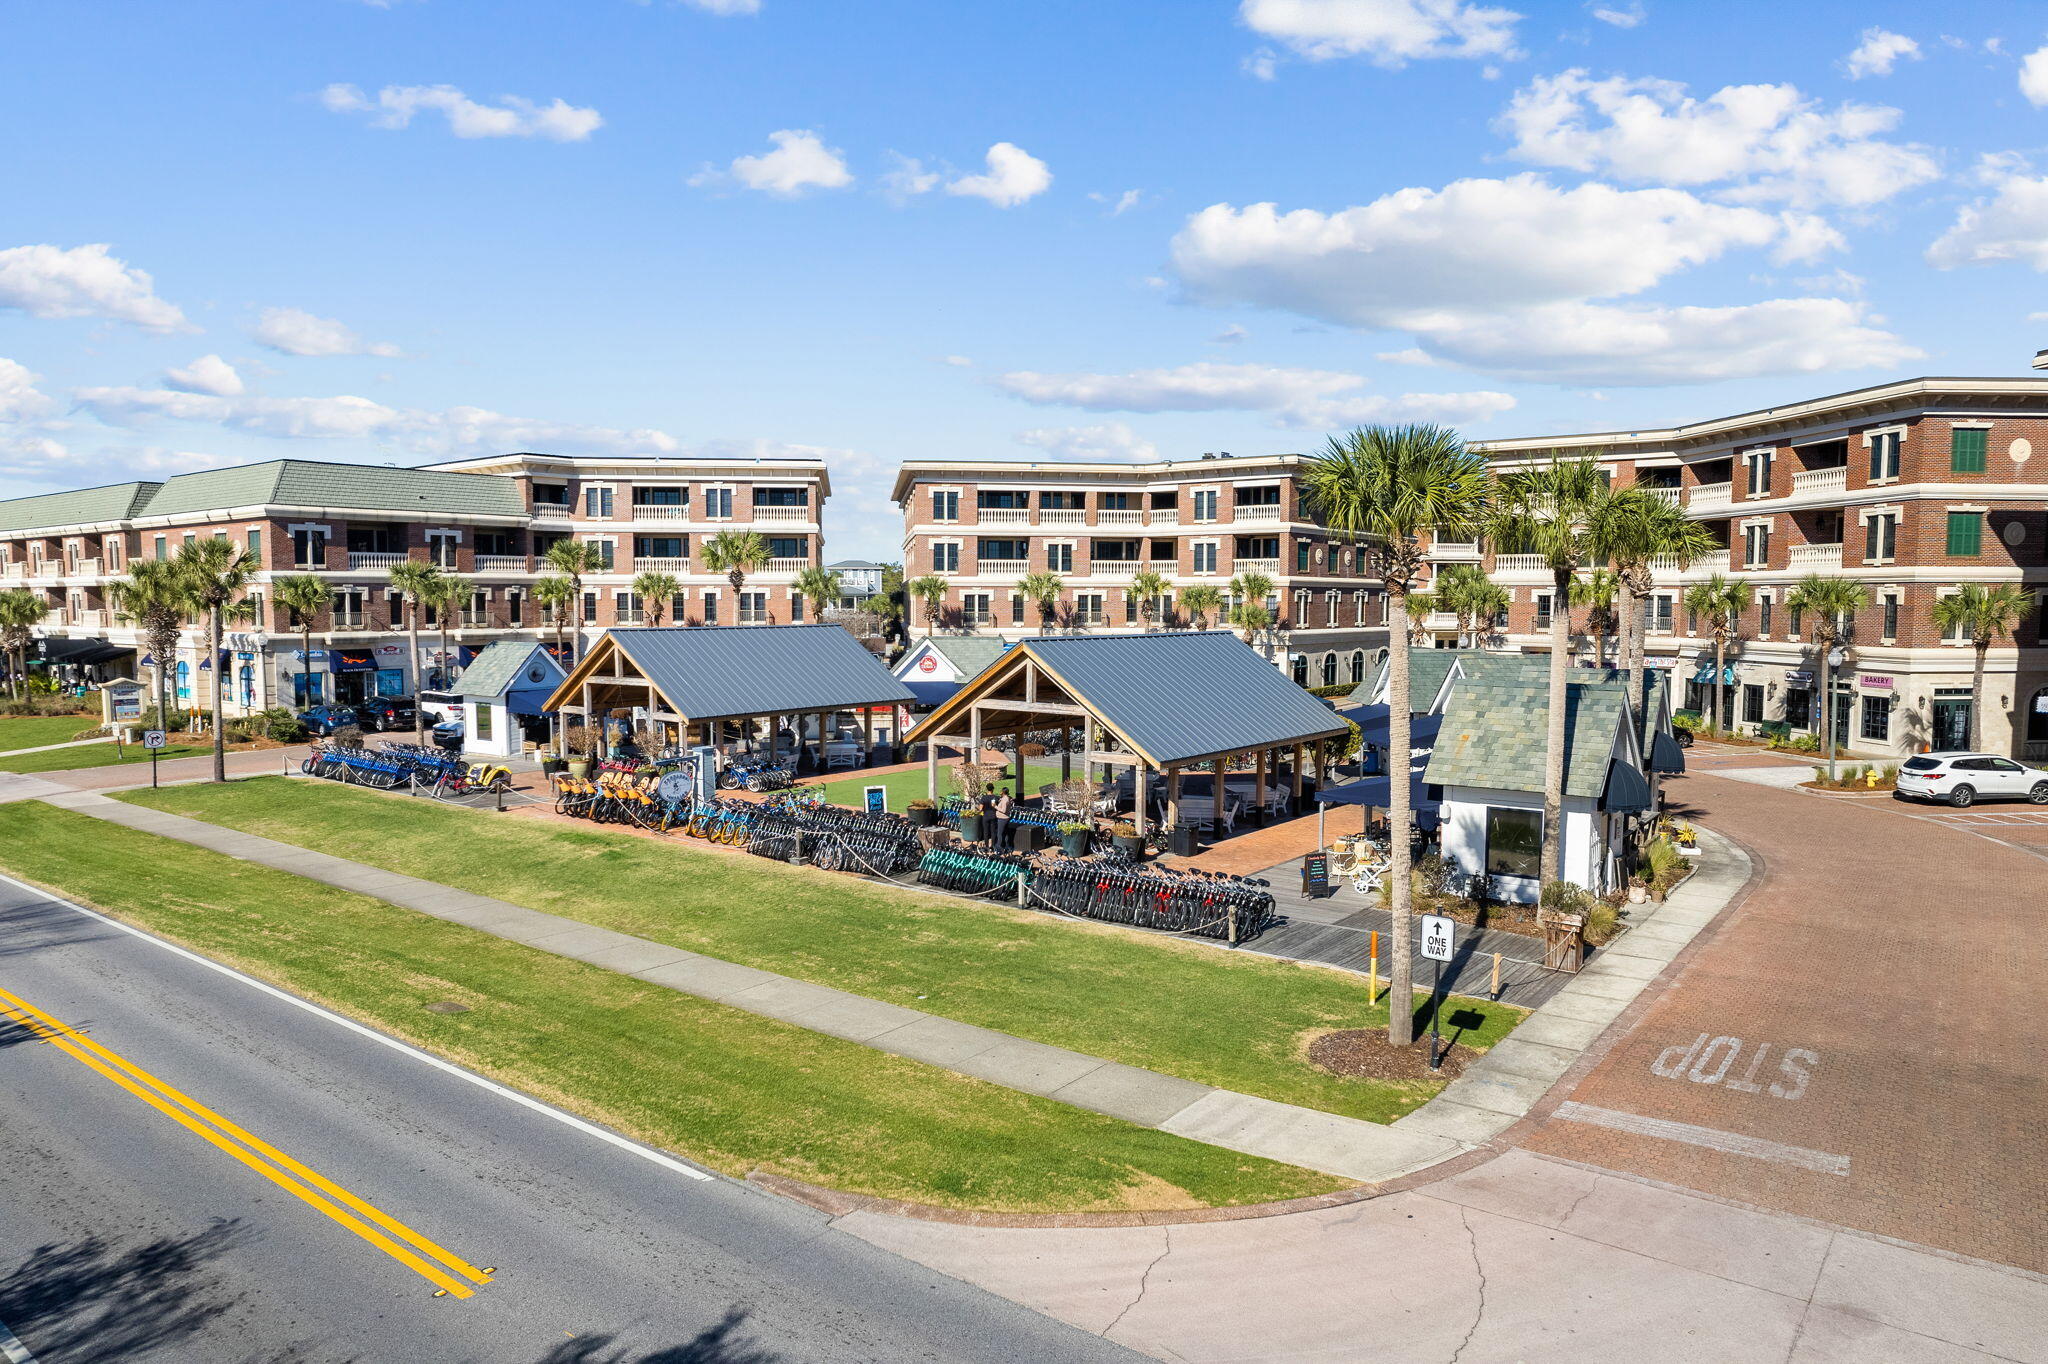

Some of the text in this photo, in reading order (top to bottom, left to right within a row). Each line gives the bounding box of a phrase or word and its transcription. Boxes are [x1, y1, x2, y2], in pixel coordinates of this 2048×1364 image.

[1864, 676, 1889, 684] BAKERY
[1427, 935, 1447, 948] ONE
[1427, 945, 1447, 957] WAY
[1651, 1033, 1819, 1100] STOP
